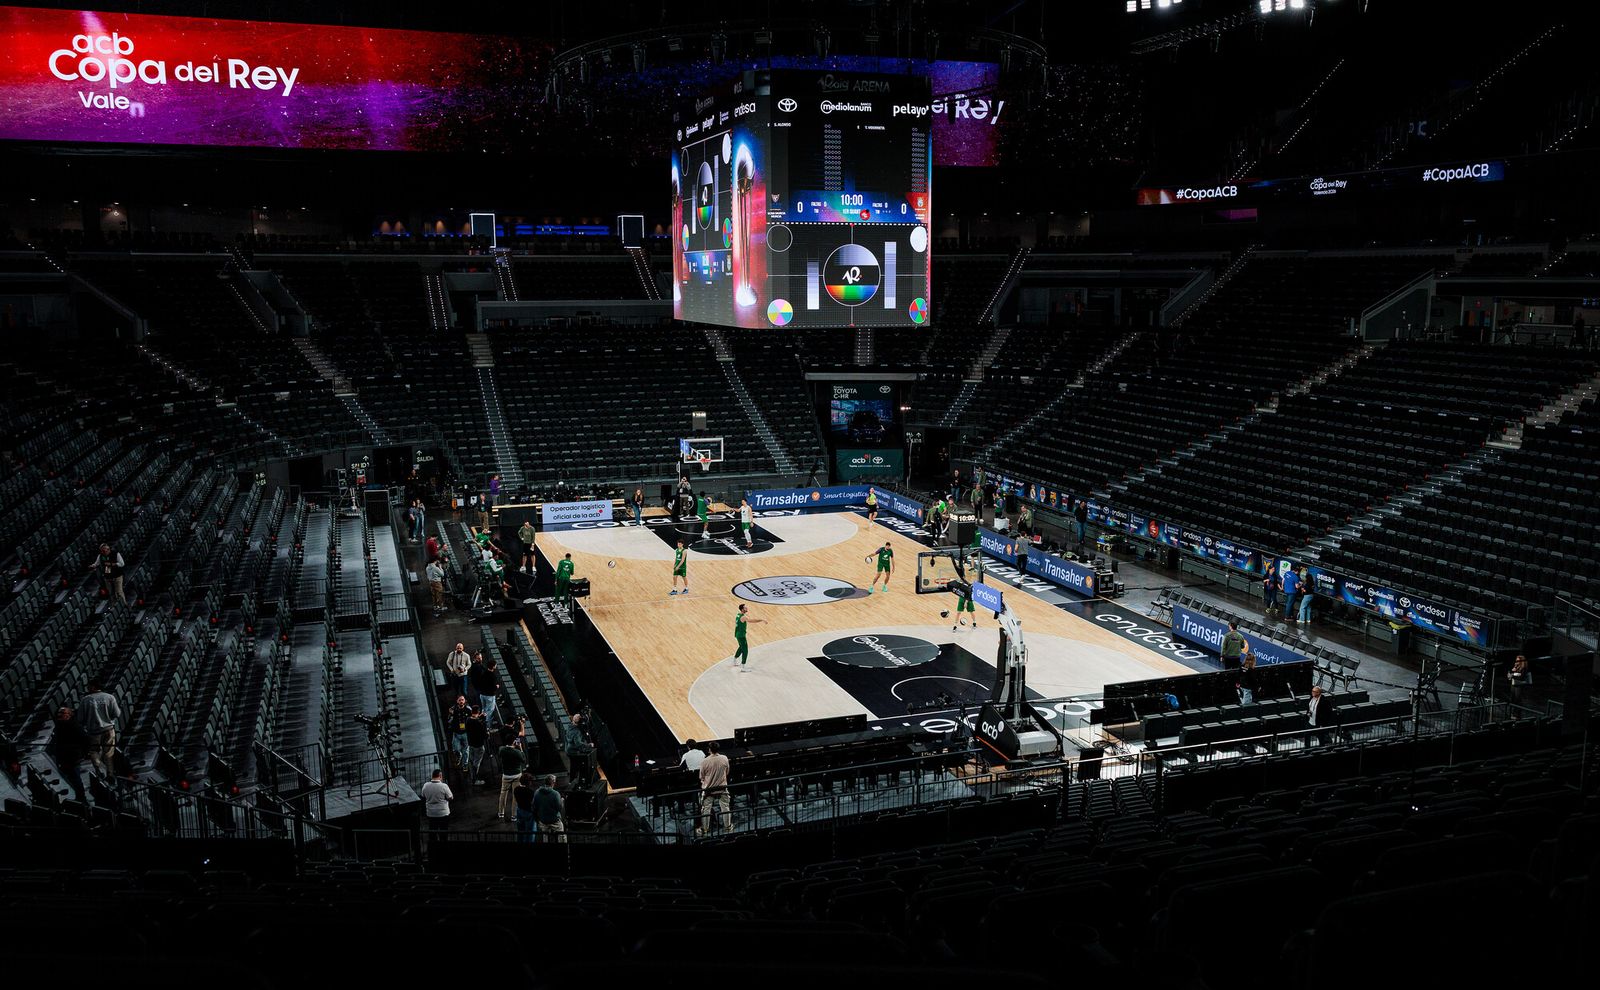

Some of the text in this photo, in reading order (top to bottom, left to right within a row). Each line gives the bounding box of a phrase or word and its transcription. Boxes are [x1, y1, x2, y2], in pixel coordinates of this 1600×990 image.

[73, 33, 134, 56] acb
[49, 49, 300, 97] Copa del Rey
[852, 80, 890, 91] ARENA
[734, 102, 756, 118] endesa
[821, 100, 872, 114] mediolanum
[955, 94, 1004, 125] Rey
[1423, 163, 1490, 183] #CopaACB
[1176, 185, 1238, 201] #CopaACB
[1310, 182, 1328, 190] Copa
[1335, 180, 1347, 189] Rey
[797, 201, 803, 213] 0
[841, 194, 863, 206] 10:00
[901, 203, 907, 214] 0
[755, 493, 810, 506] Transaher
[823, 492, 842, 500] Smart
[550, 505, 580, 513] Operador
[893, 497, 918, 518] Transaher
[980, 536, 1006, 556] ansaher
[1043, 557, 1085, 588] Transaher
[976, 589, 999, 605] endesa
[1415, 602, 1446, 619] endesa
[1095, 613, 1208, 660] endesa
[1181, 613, 1225, 647] Transah
[981, 721, 998, 740] acb
